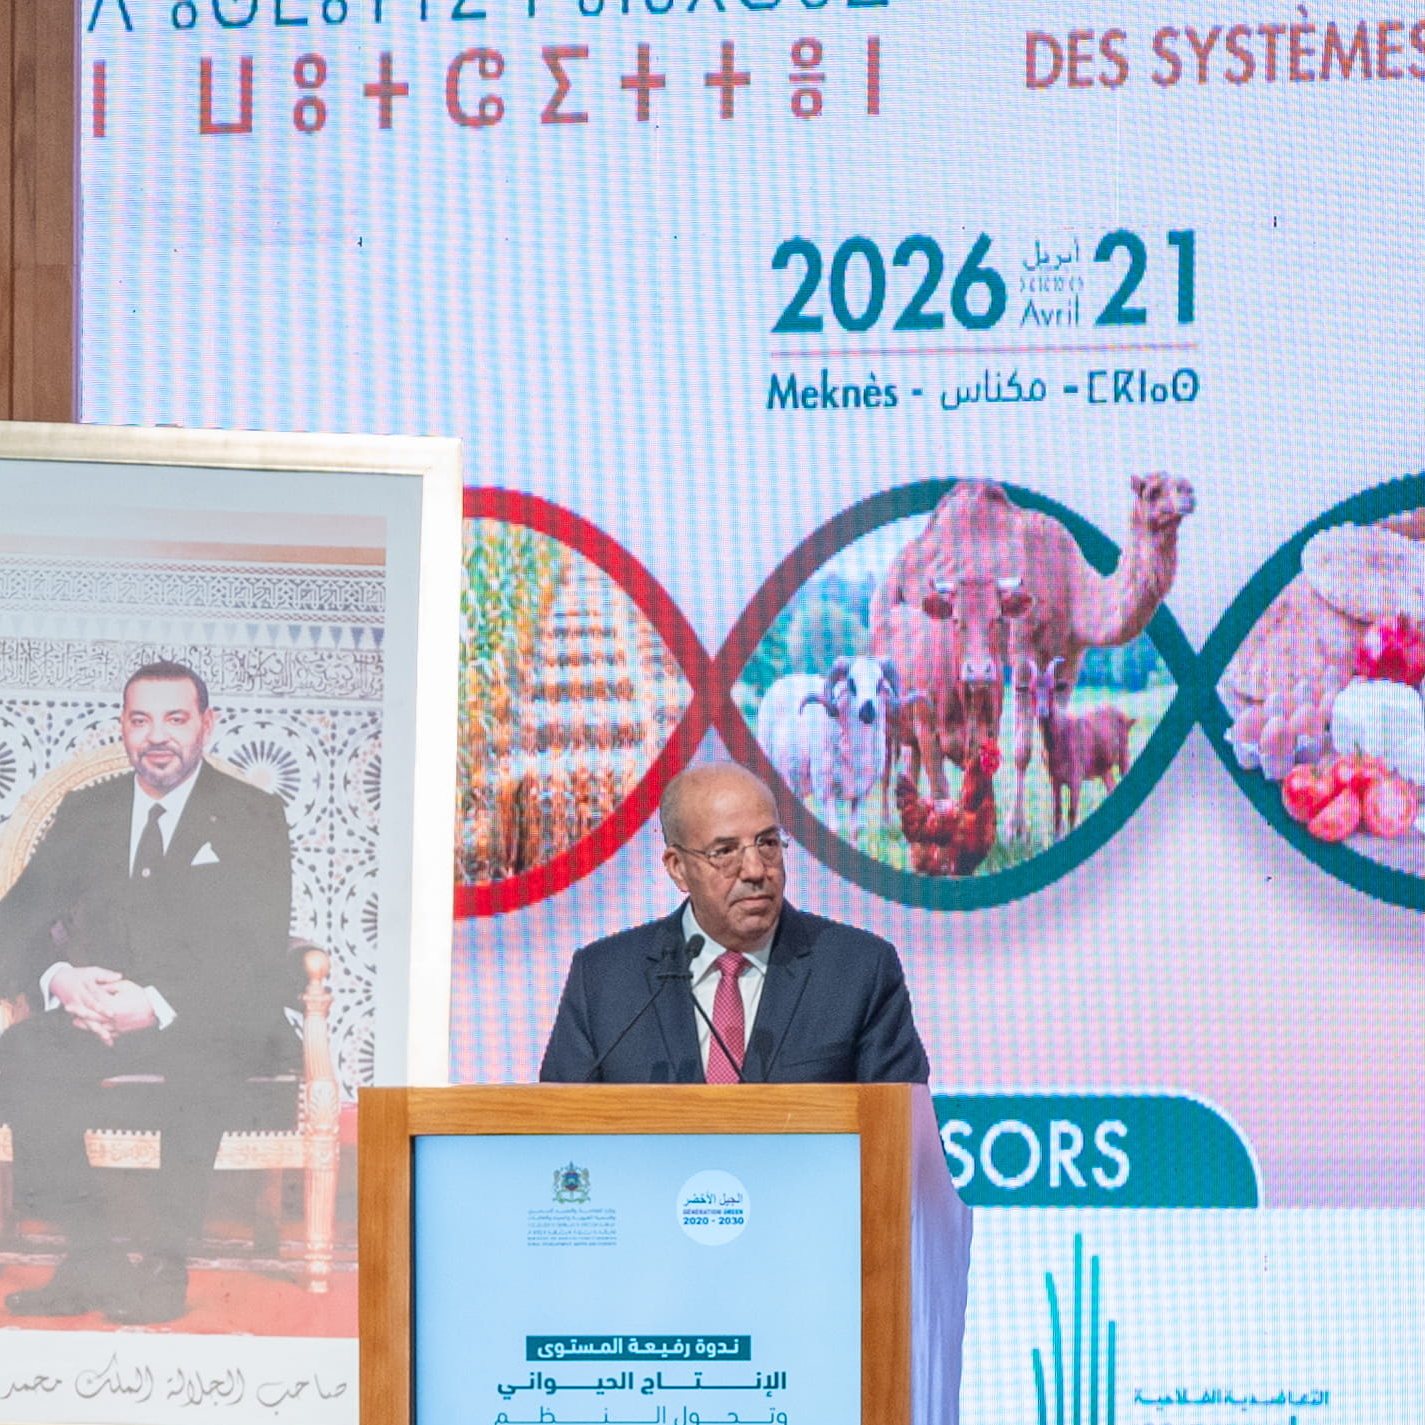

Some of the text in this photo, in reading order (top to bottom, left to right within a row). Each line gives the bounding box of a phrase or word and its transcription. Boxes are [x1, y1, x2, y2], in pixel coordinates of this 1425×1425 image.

[1026, 29, 1130, 90] DES
[770, 228, 1196, 333] 2026 21
[1020, 294, 1080, 327] Avril
[768, 368, 898, 410] Meknès
[941, 369, 1047, 411] مكناس
[682, 1217, 709, 1225] 2020
[718, 1217, 744, 1225] 2030
[537, 1337, 739, 1358] ندوة رفيعة المستوى
[75, 1352, 154, 1403] الملك
[256, 1373, 348, 1416] صاحب
[497, 1371, 787, 1400] الإنتاج الحيواني
